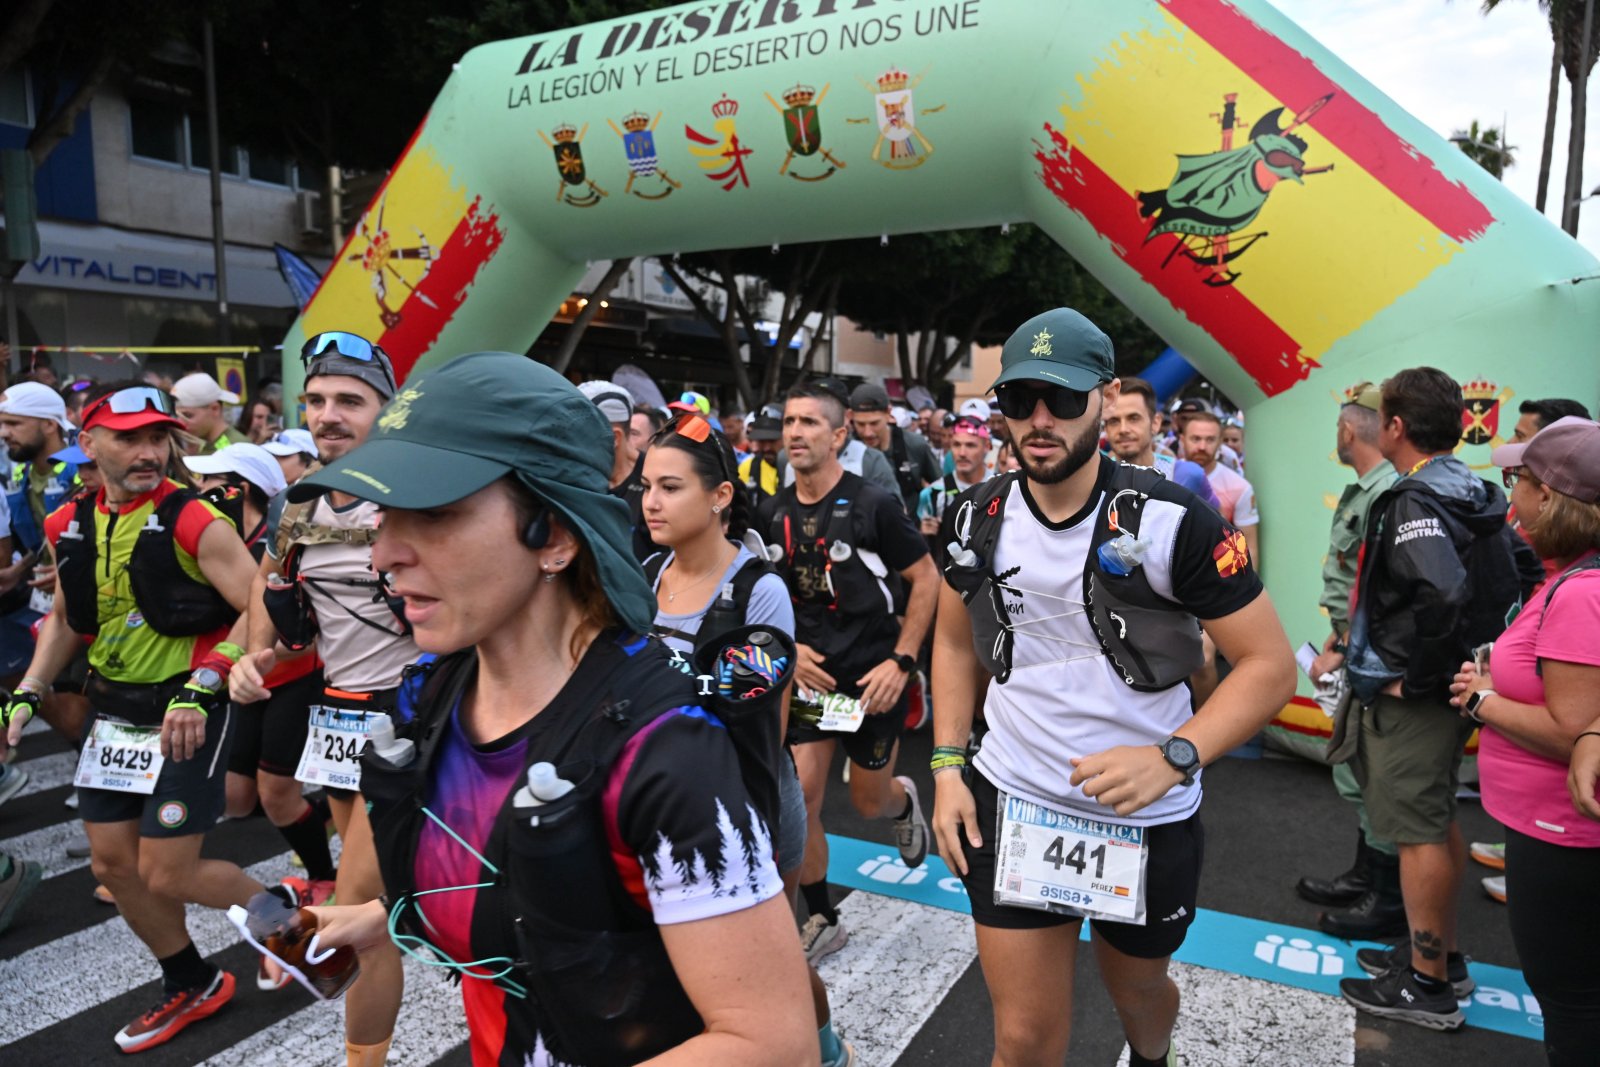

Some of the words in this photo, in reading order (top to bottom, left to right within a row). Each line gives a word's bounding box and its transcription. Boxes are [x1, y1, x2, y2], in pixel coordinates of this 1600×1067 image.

[507, 85, 532, 109] LA
[539, 62, 625, 103] LEGIÓN
[633, 62, 648, 86] Y
[656, 57, 684, 83] EL
[693, 28, 828, 76] DESIERTO
[839, 14, 902, 50] NOS
[914, 0, 980, 36] UNE
[514, 33, 584, 76] LA
[31, 255, 216, 290] VITALDENT
[1394, 527, 1446, 545] ARBITRAL
[100, 746, 153, 771] 8429
[1043, 835, 1107, 879] 441
[1040, 885, 1082, 904] asisa
